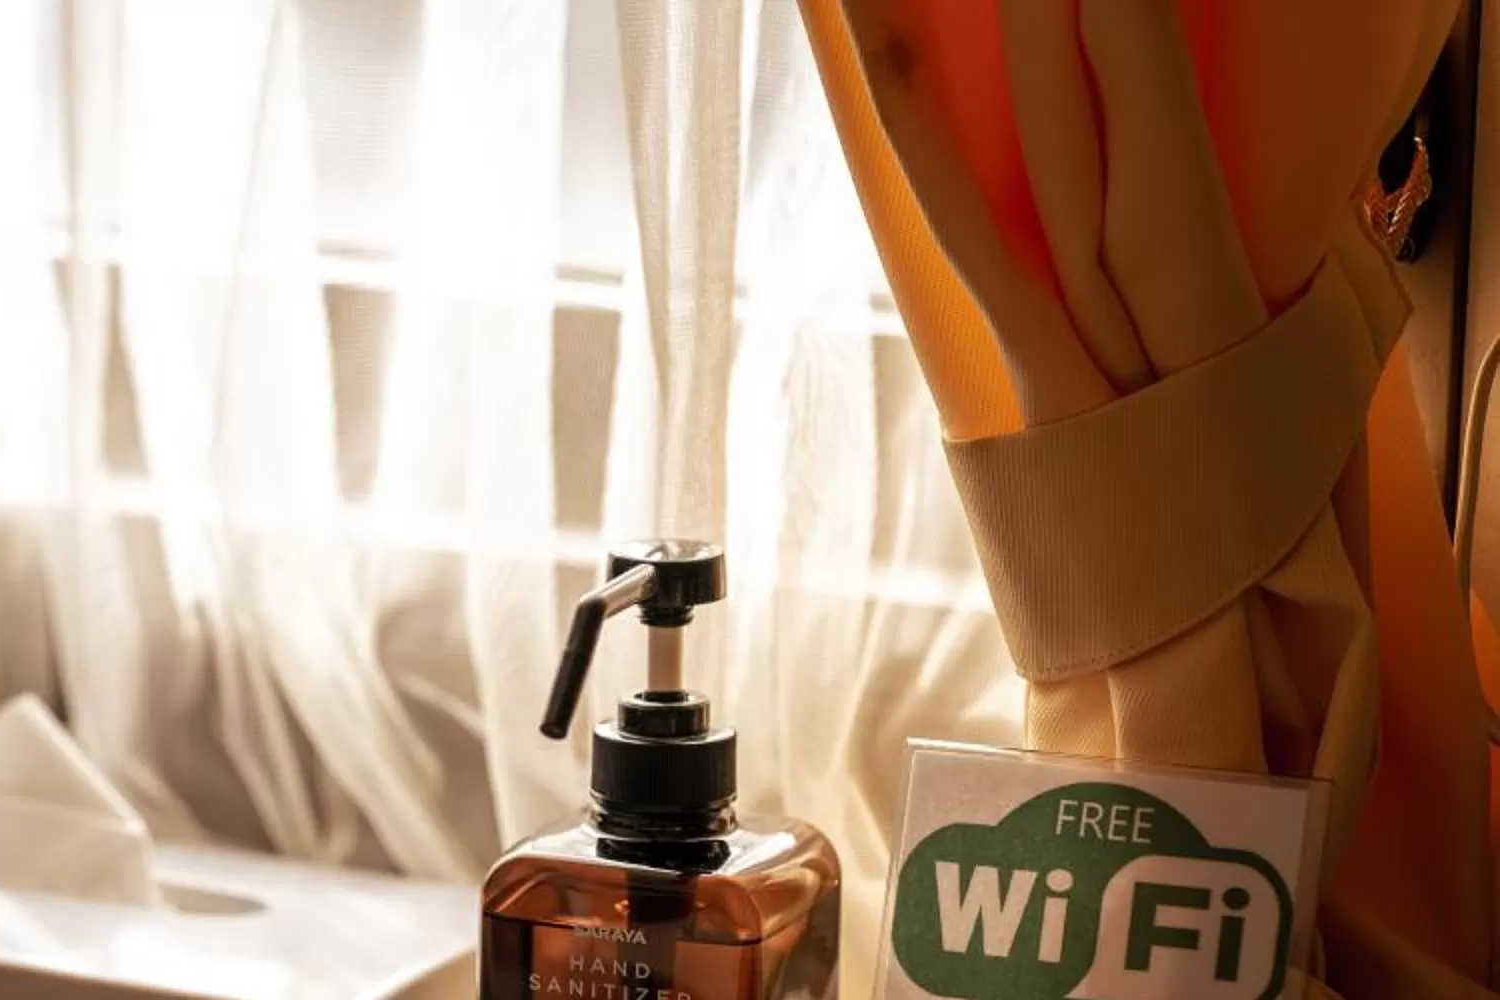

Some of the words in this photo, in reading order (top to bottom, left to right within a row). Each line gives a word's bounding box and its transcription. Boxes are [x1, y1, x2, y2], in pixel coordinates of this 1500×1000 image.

[1055, 799, 1155, 844] FREE
[572, 924, 648, 945] SARAYA
[569, 955, 650, 979] HAND
